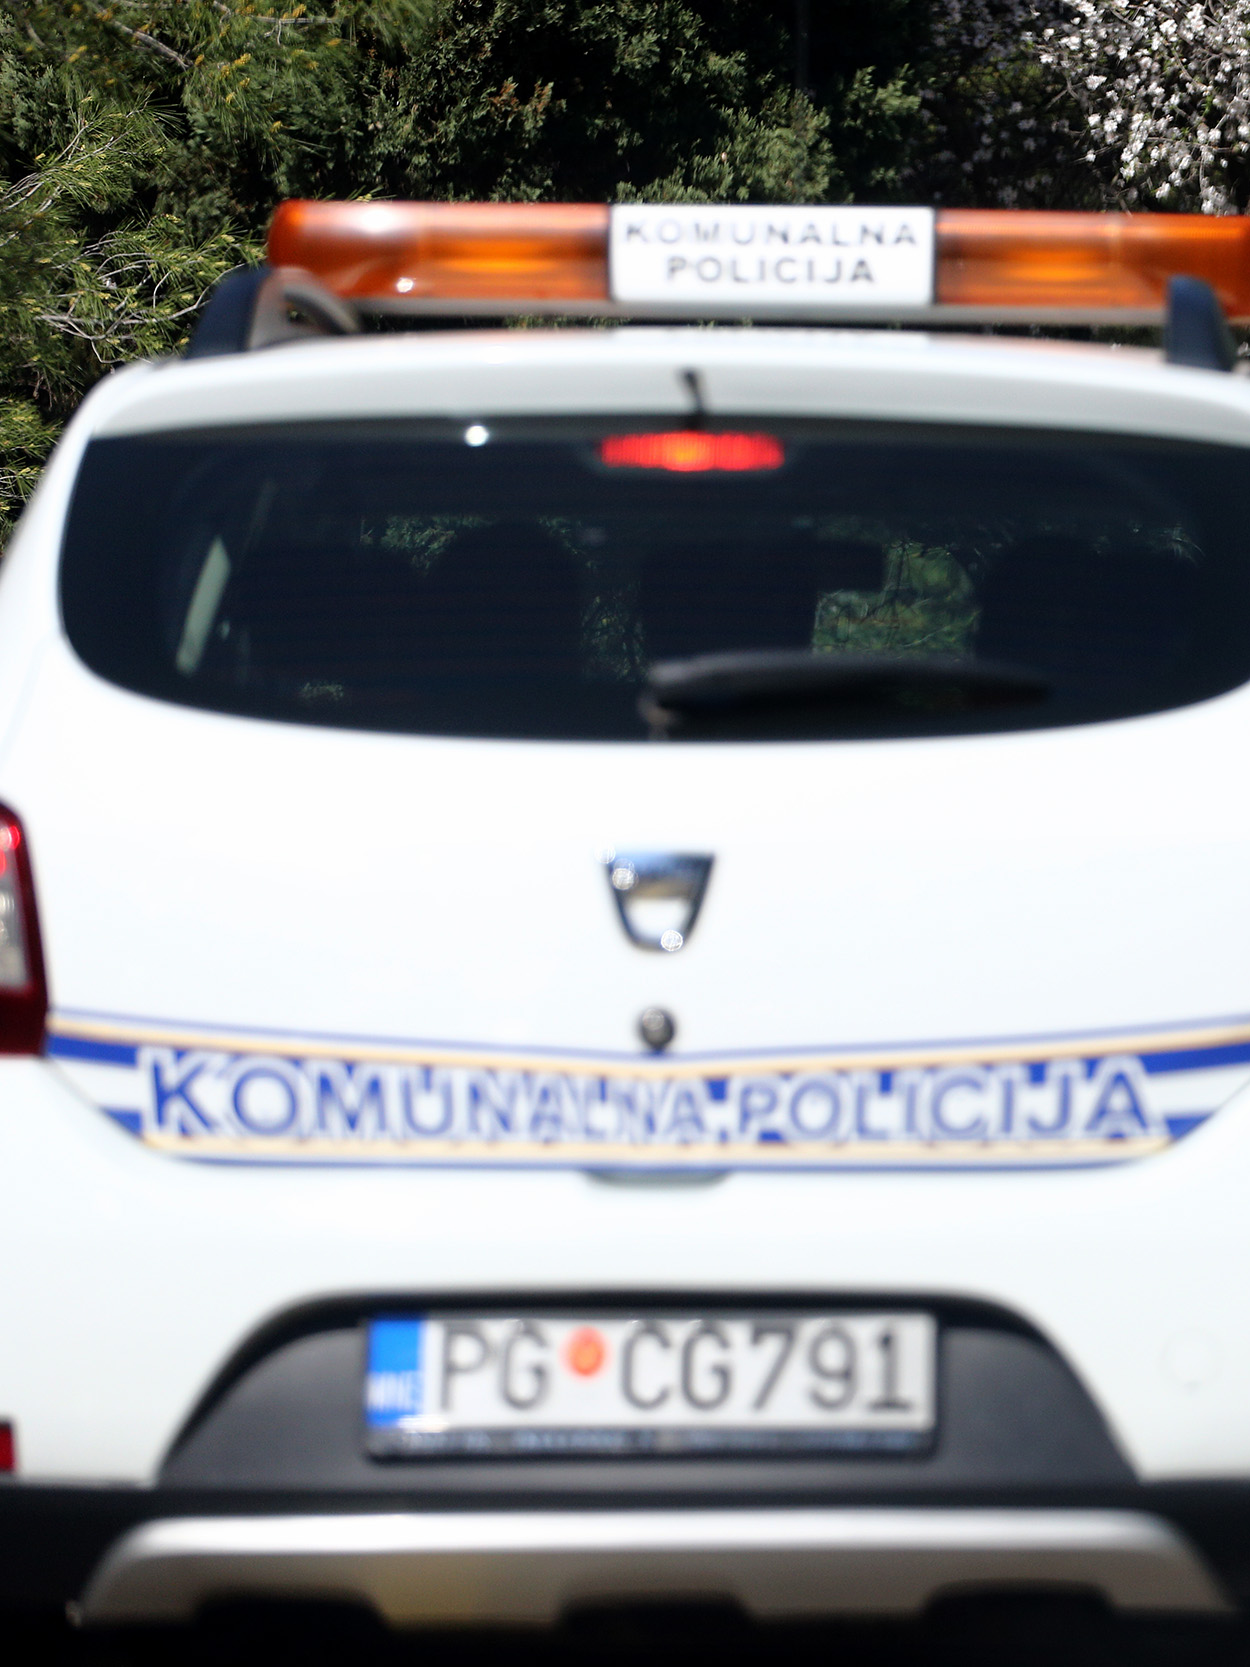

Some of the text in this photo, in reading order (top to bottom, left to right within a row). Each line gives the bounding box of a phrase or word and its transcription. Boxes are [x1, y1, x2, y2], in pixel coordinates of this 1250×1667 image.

[625, 219, 918, 246] KOMUNALNA
[666, 255, 876, 284] POLICIJA
[142, 1046, 1168, 1142] KOMUNALNA POLICIJA
[440, 1320, 916, 1412] PG CG791
